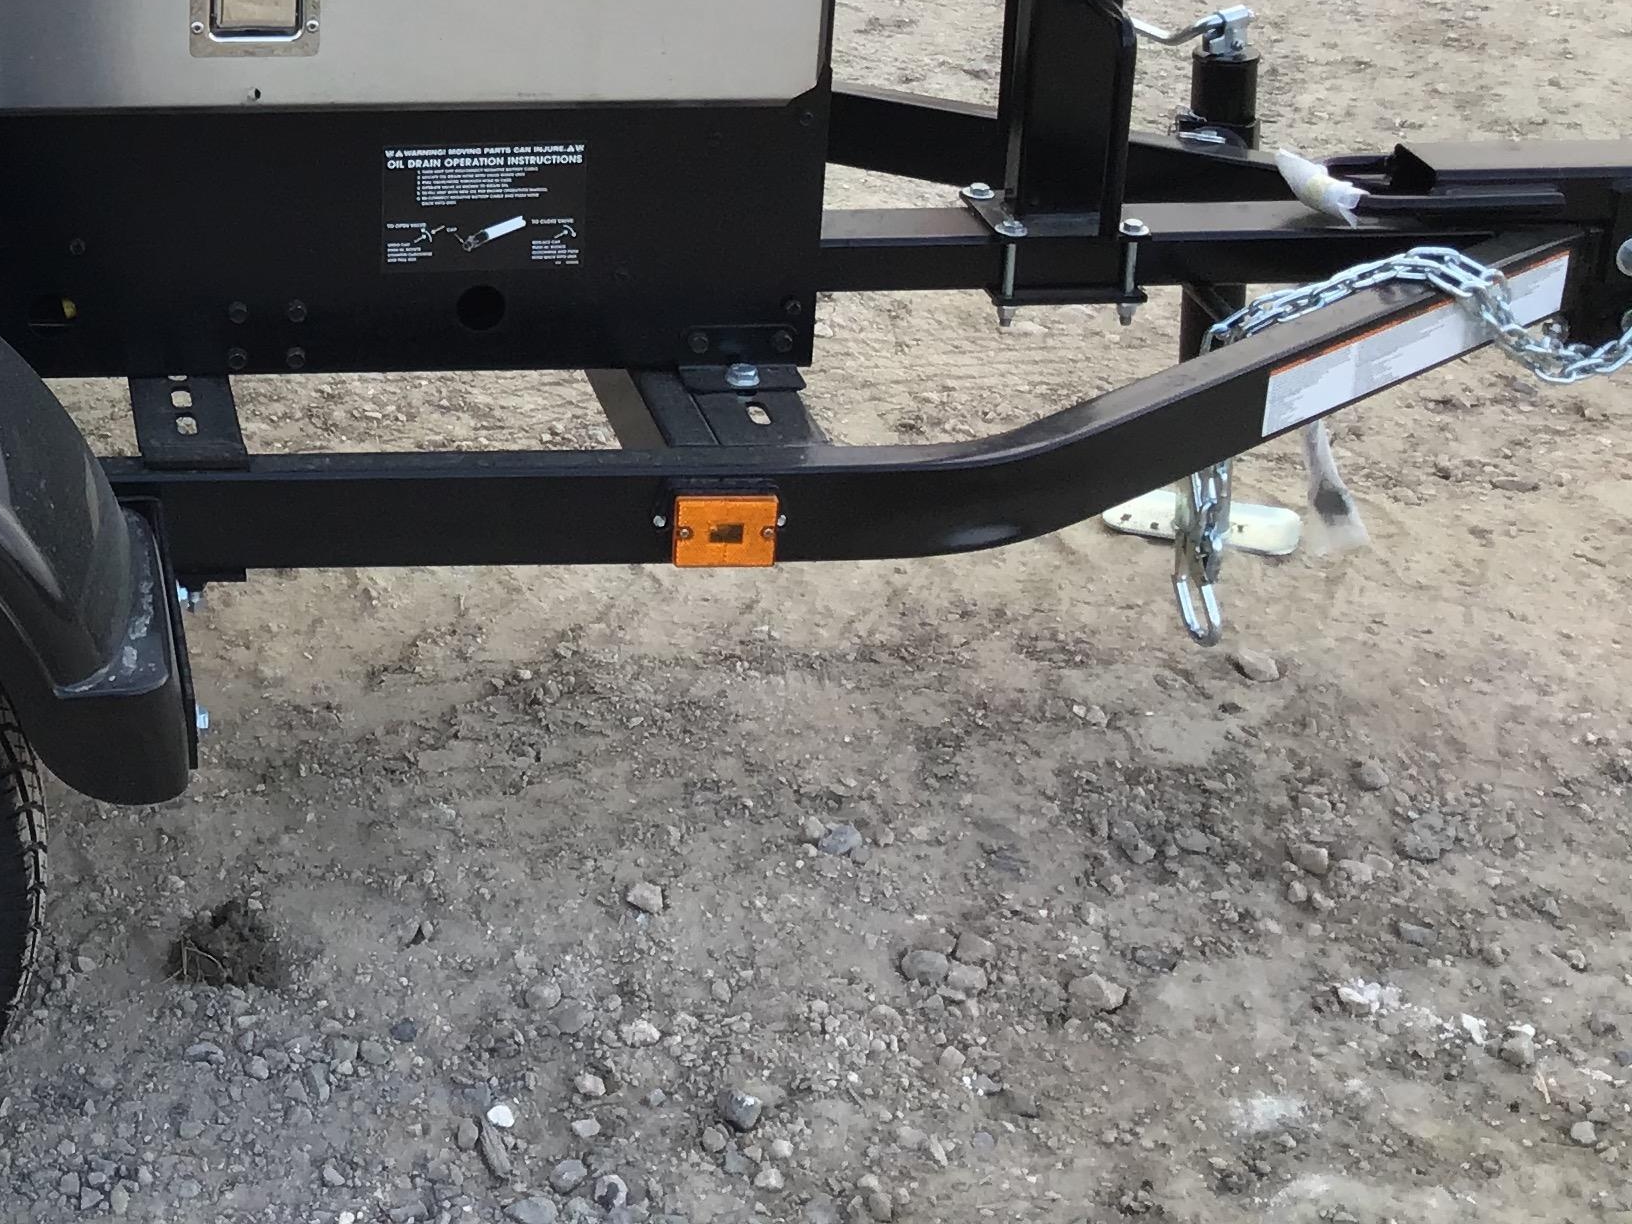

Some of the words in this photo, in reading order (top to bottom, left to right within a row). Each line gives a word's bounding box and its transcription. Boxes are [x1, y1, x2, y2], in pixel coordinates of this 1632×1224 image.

[387, 159, 404, 169] OIL
[407, 158, 441, 168] DRAIN
[444, 157, 504, 167] OPERATION
[507, 155, 583, 165] INSTRUCTIONS
